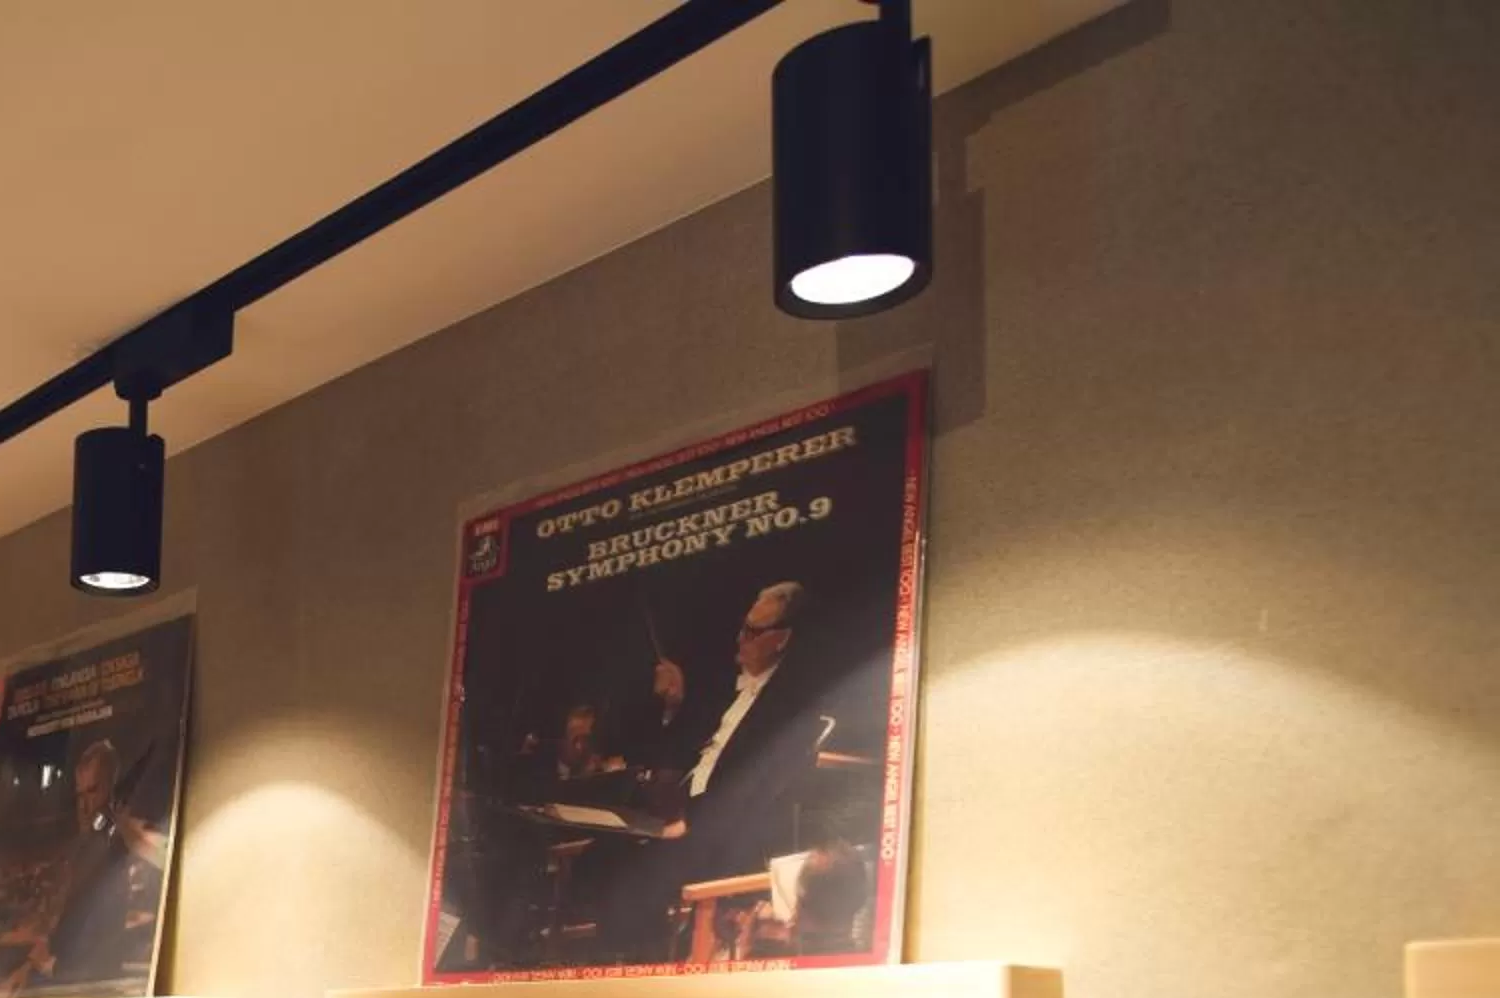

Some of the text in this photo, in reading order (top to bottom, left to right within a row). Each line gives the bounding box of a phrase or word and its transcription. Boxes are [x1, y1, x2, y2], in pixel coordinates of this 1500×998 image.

[536, 499, 622, 539] OTTO
[628, 426, 857, 511] KLEMPERER
[546, 523, 737, 592] SYMPHONY
[587, 489, 780, 562] BRUCKNER
